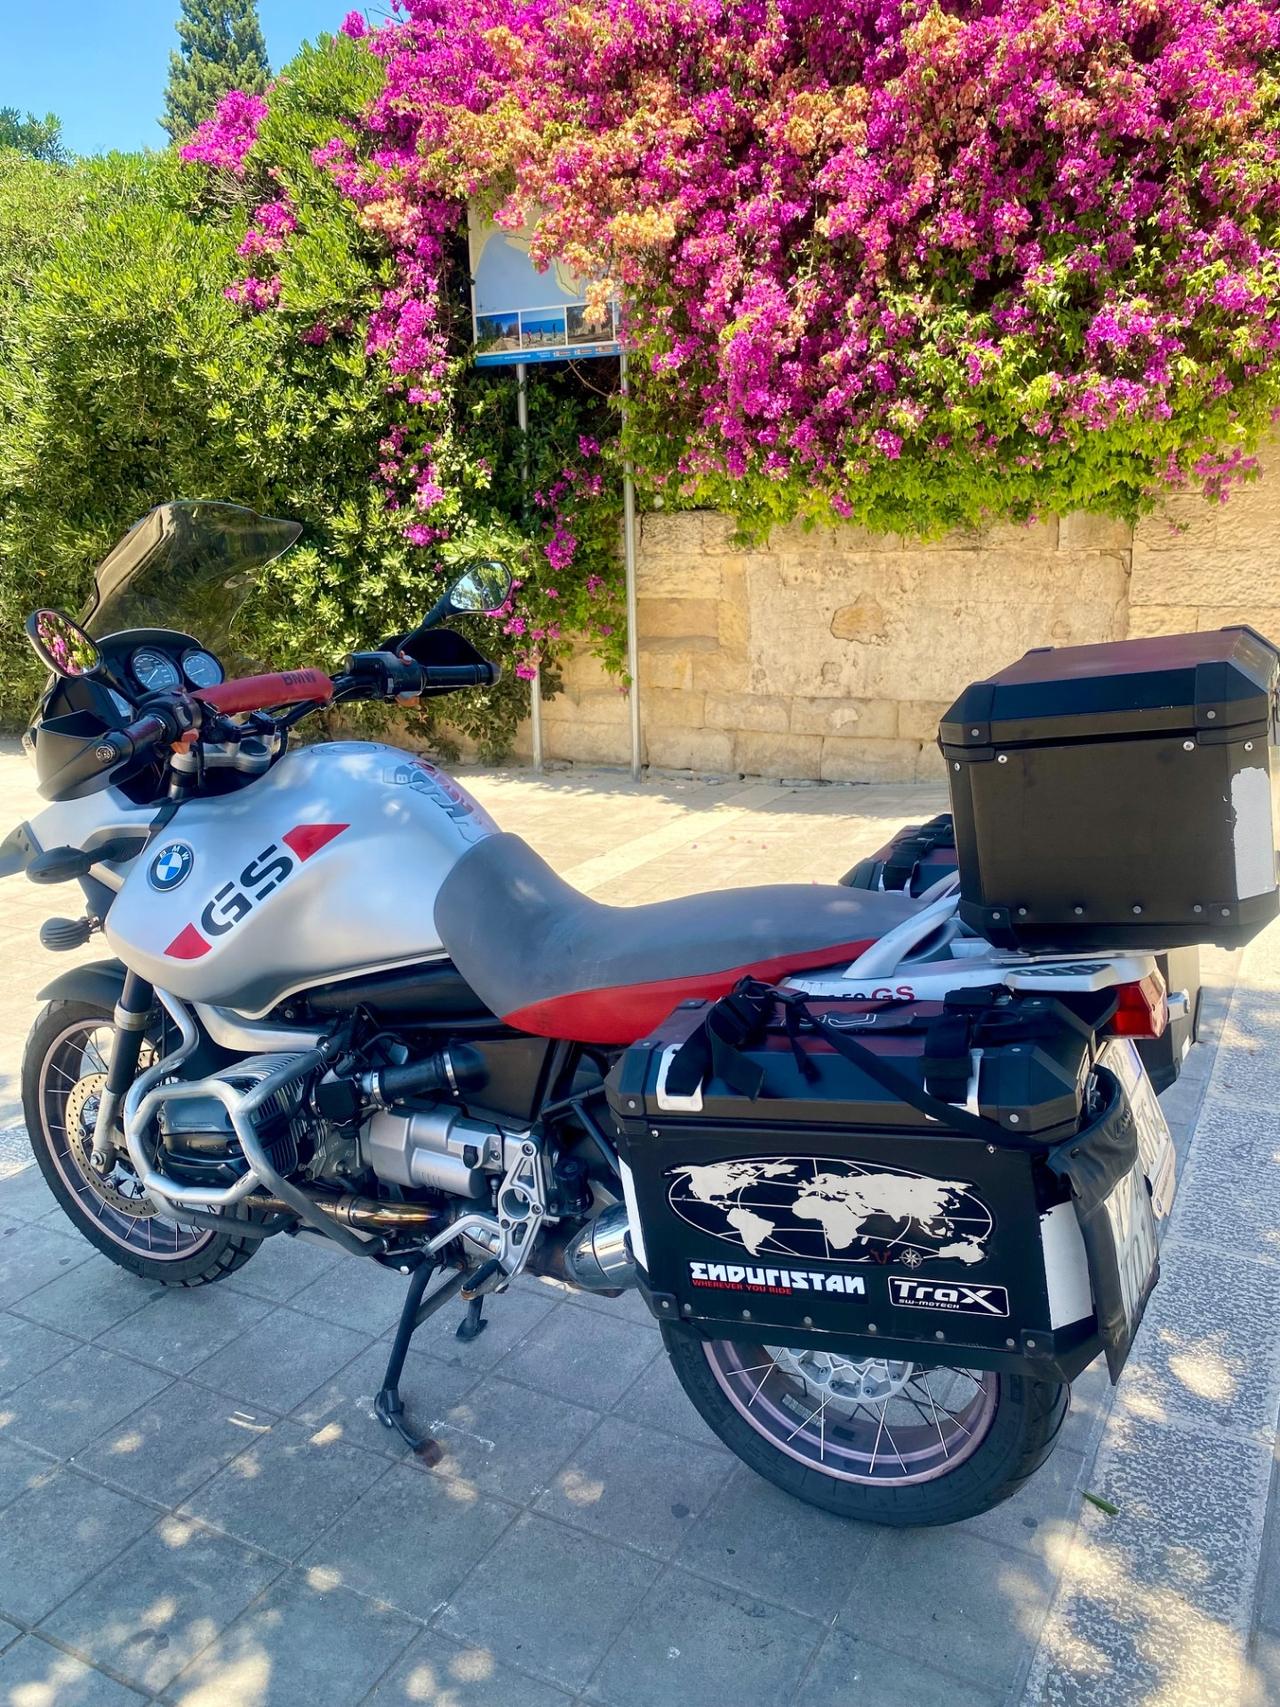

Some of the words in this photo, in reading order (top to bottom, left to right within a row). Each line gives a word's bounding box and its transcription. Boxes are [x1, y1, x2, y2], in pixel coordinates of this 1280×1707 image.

[281, 670, 317, 687] BMW
[159, 845, 191, 861] BMW
[201, 844, 294, 936] GS
[689, 1261, 866, 1295] ENDURISTAN
[692, 1279, 744, 1291] WHEREVER
[745, 1284, 767, 1293] YOU
[769, 1286, 793, 1295] RIDE
